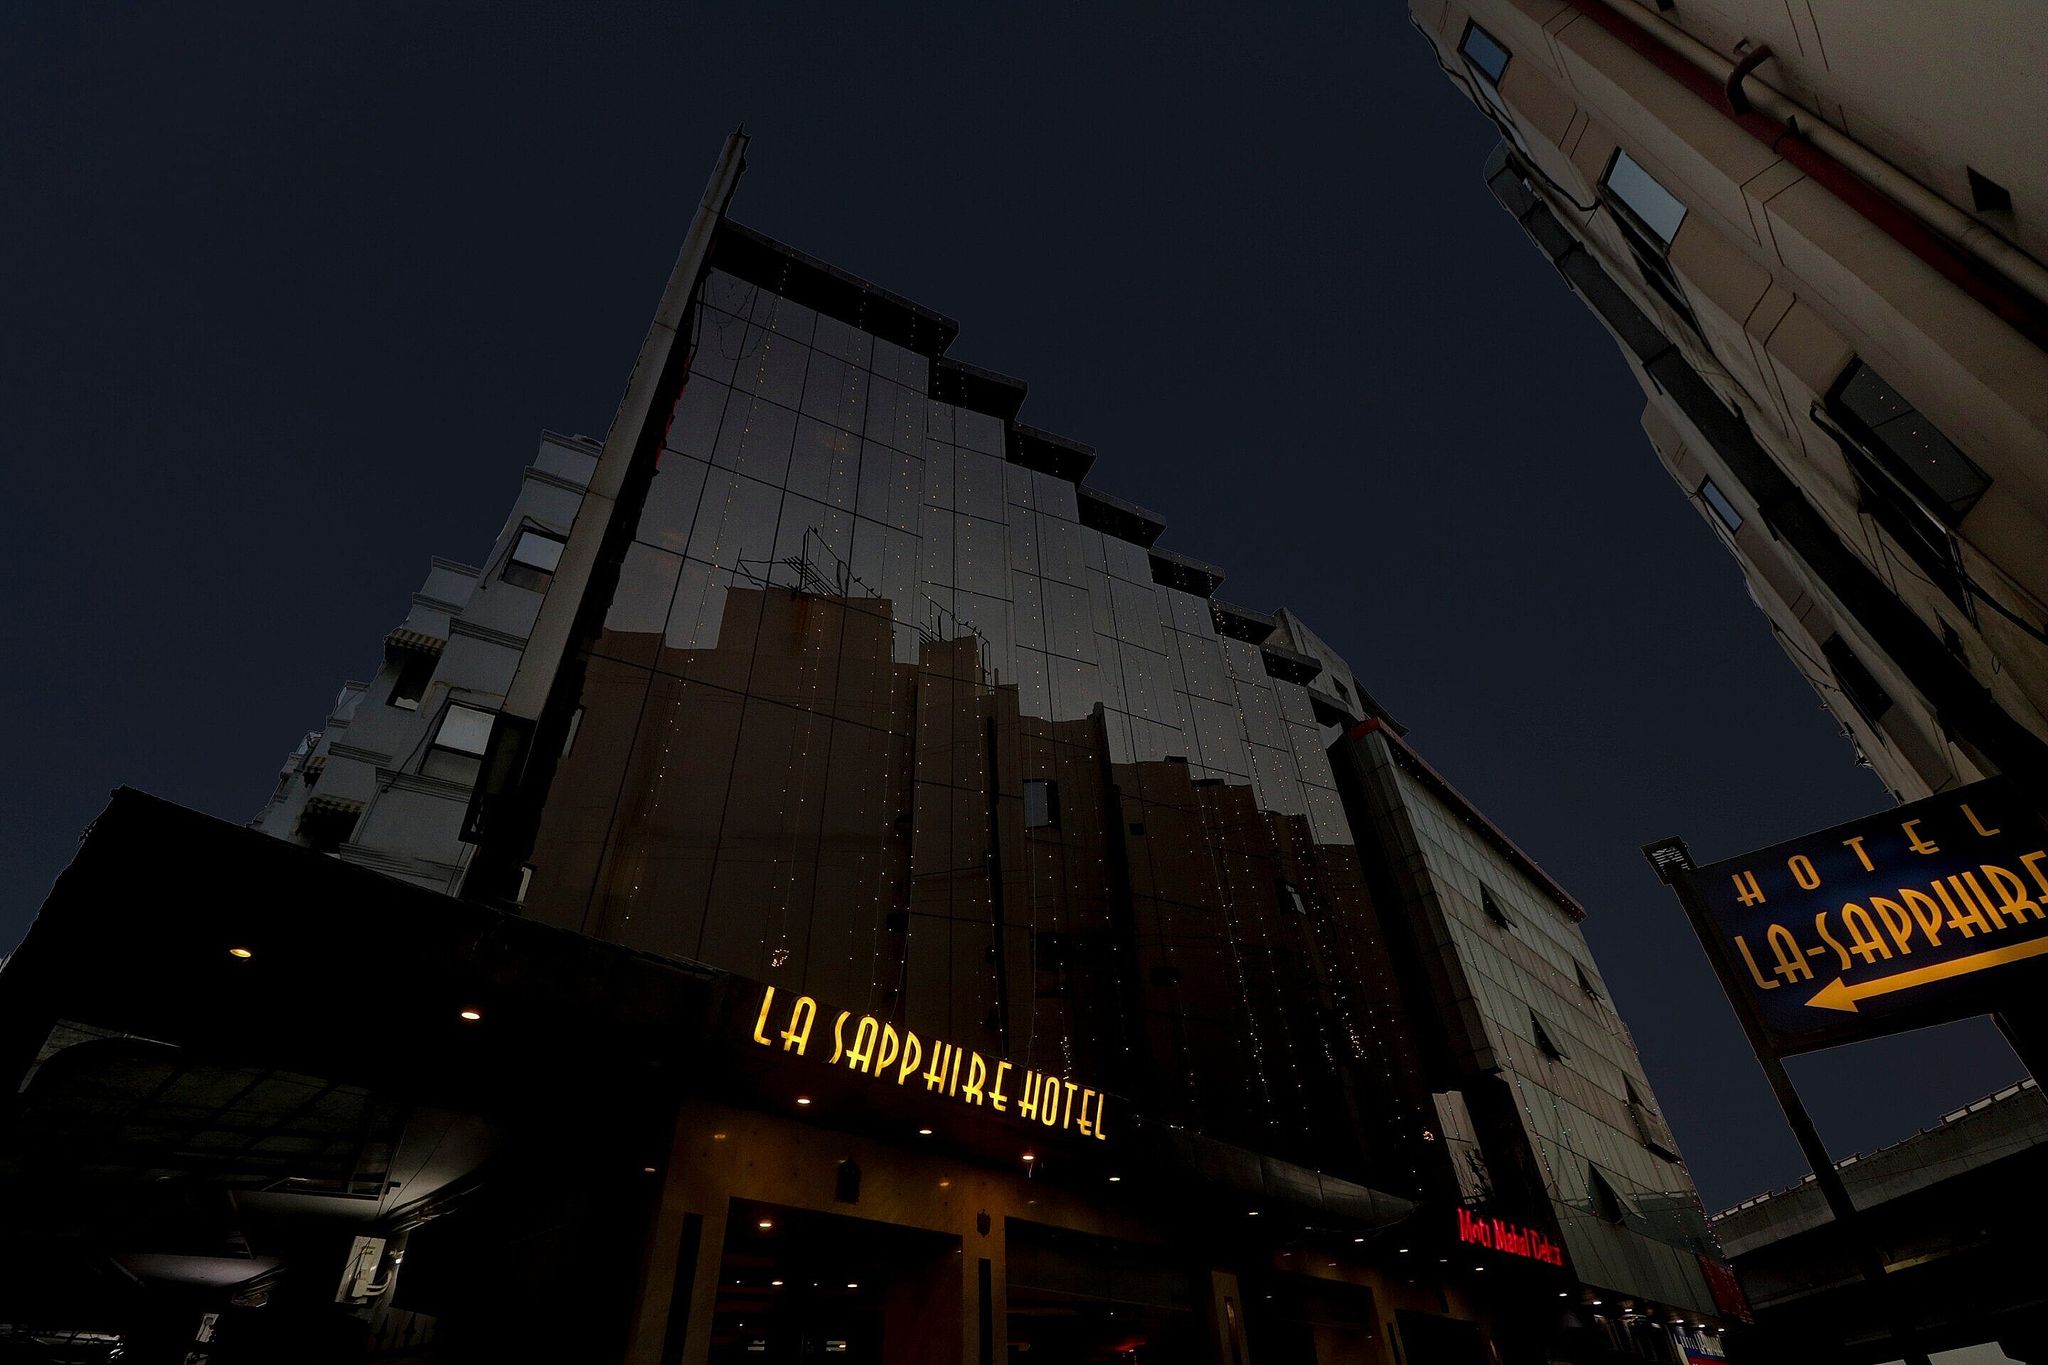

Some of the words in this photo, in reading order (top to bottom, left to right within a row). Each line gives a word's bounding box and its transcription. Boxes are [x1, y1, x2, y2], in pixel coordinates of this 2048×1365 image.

[1731, 803, 2001, 908] HOTEL
[753, 985, 818, 1056] LA
[829, 1010, 1013, 1112] SAPPHIRE
[1018, 1069, 1107, 1141] HOTEL
